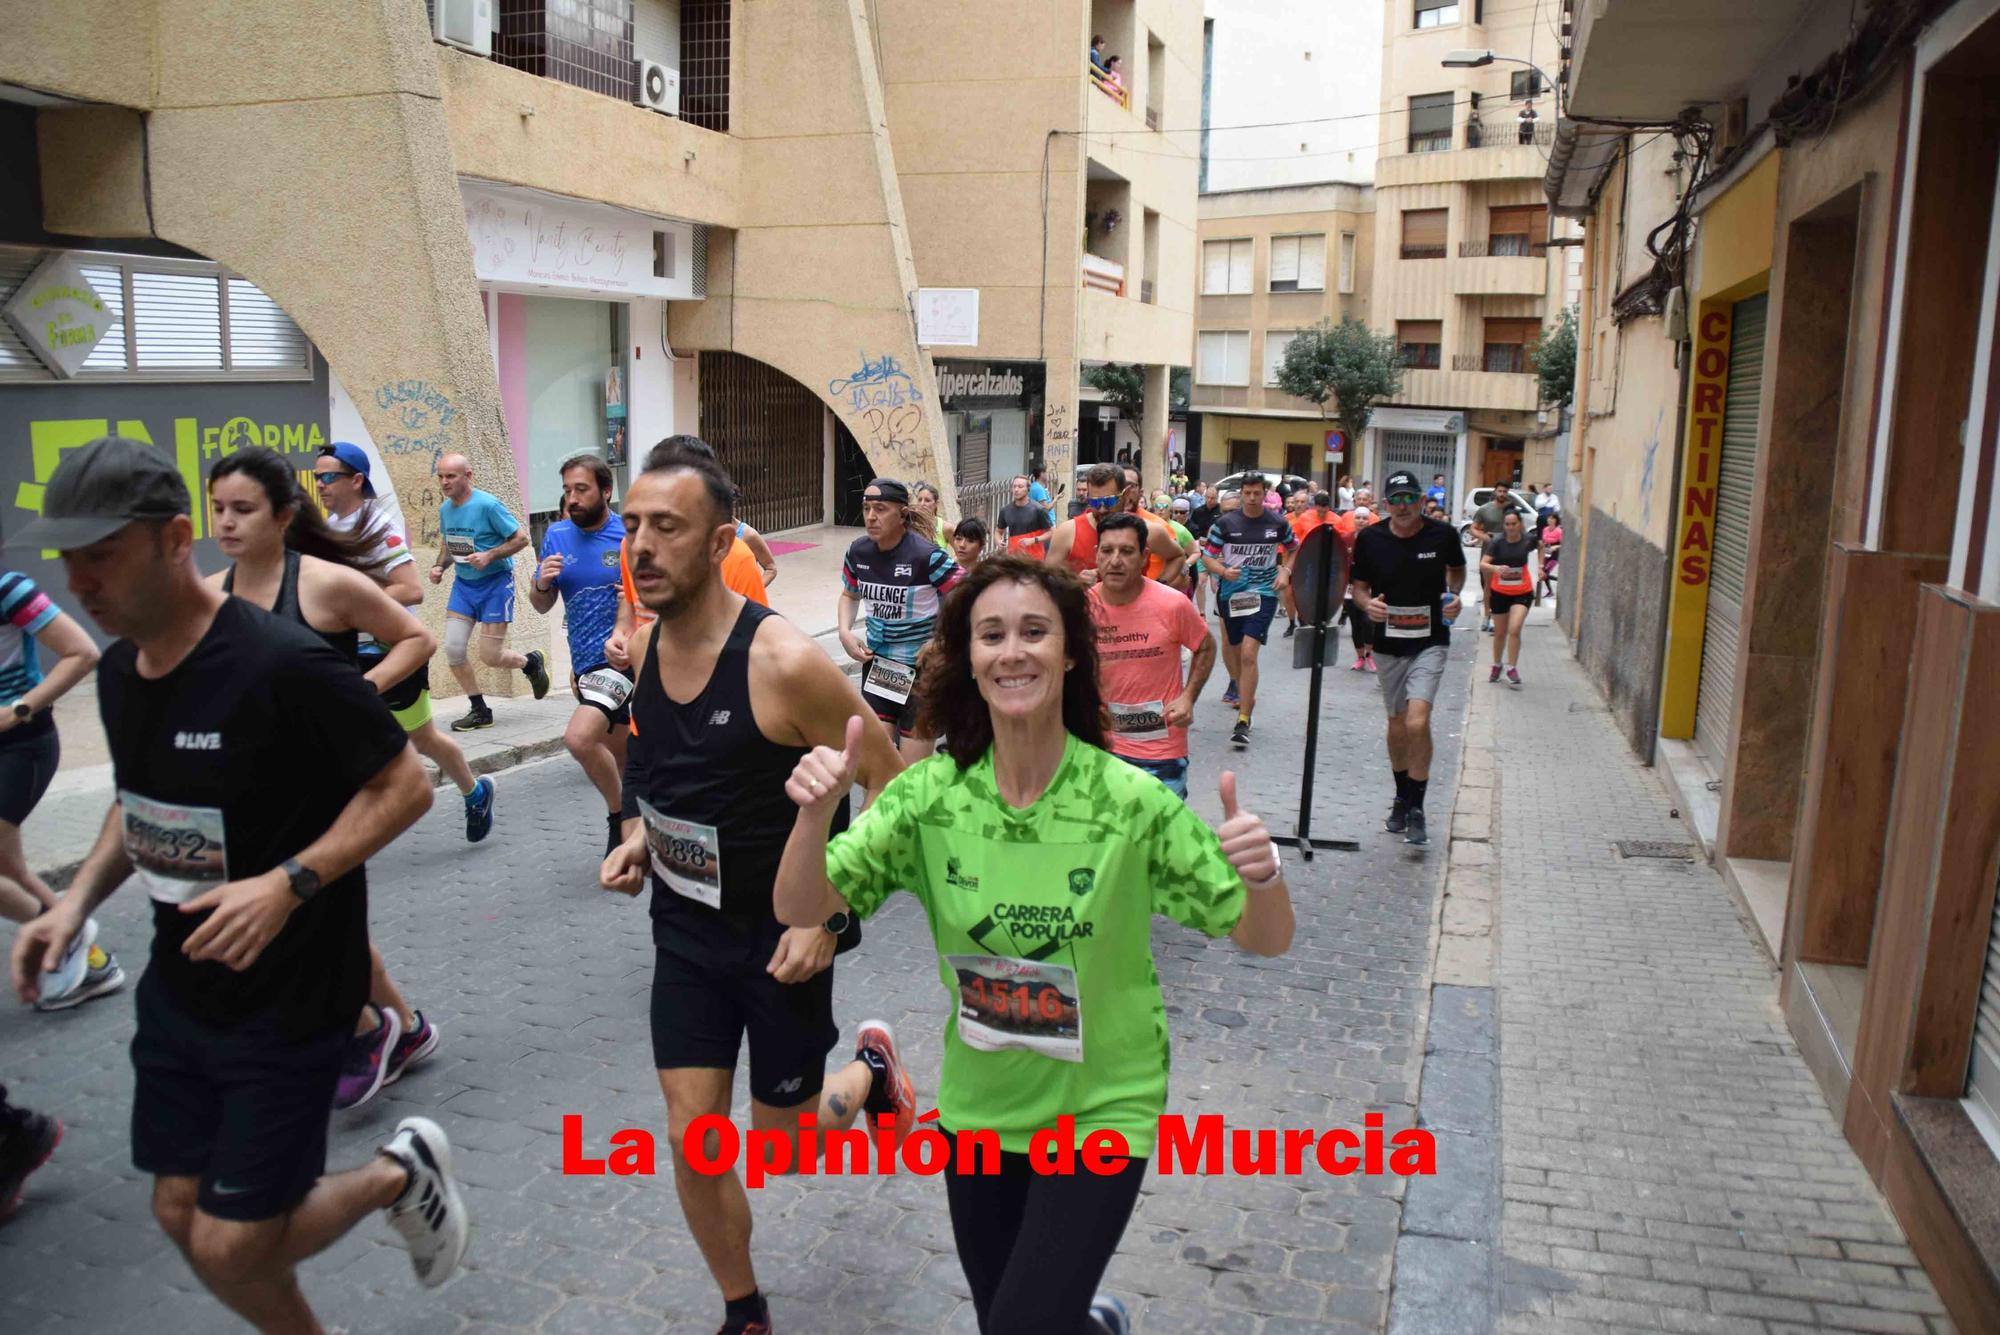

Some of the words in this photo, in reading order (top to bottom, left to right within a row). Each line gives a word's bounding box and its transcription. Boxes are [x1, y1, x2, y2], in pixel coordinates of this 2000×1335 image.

[1680, 312, 1728, 586] CORTINAS
[872, 602, 903, 620] ROOM
[174, 731, 222, 749] #LIVE
[994, 902, 1076, 923] CARRERA
[1010, 921, 1094, 940] POPULAR
[971, 975, 1064, 1020] 1516
